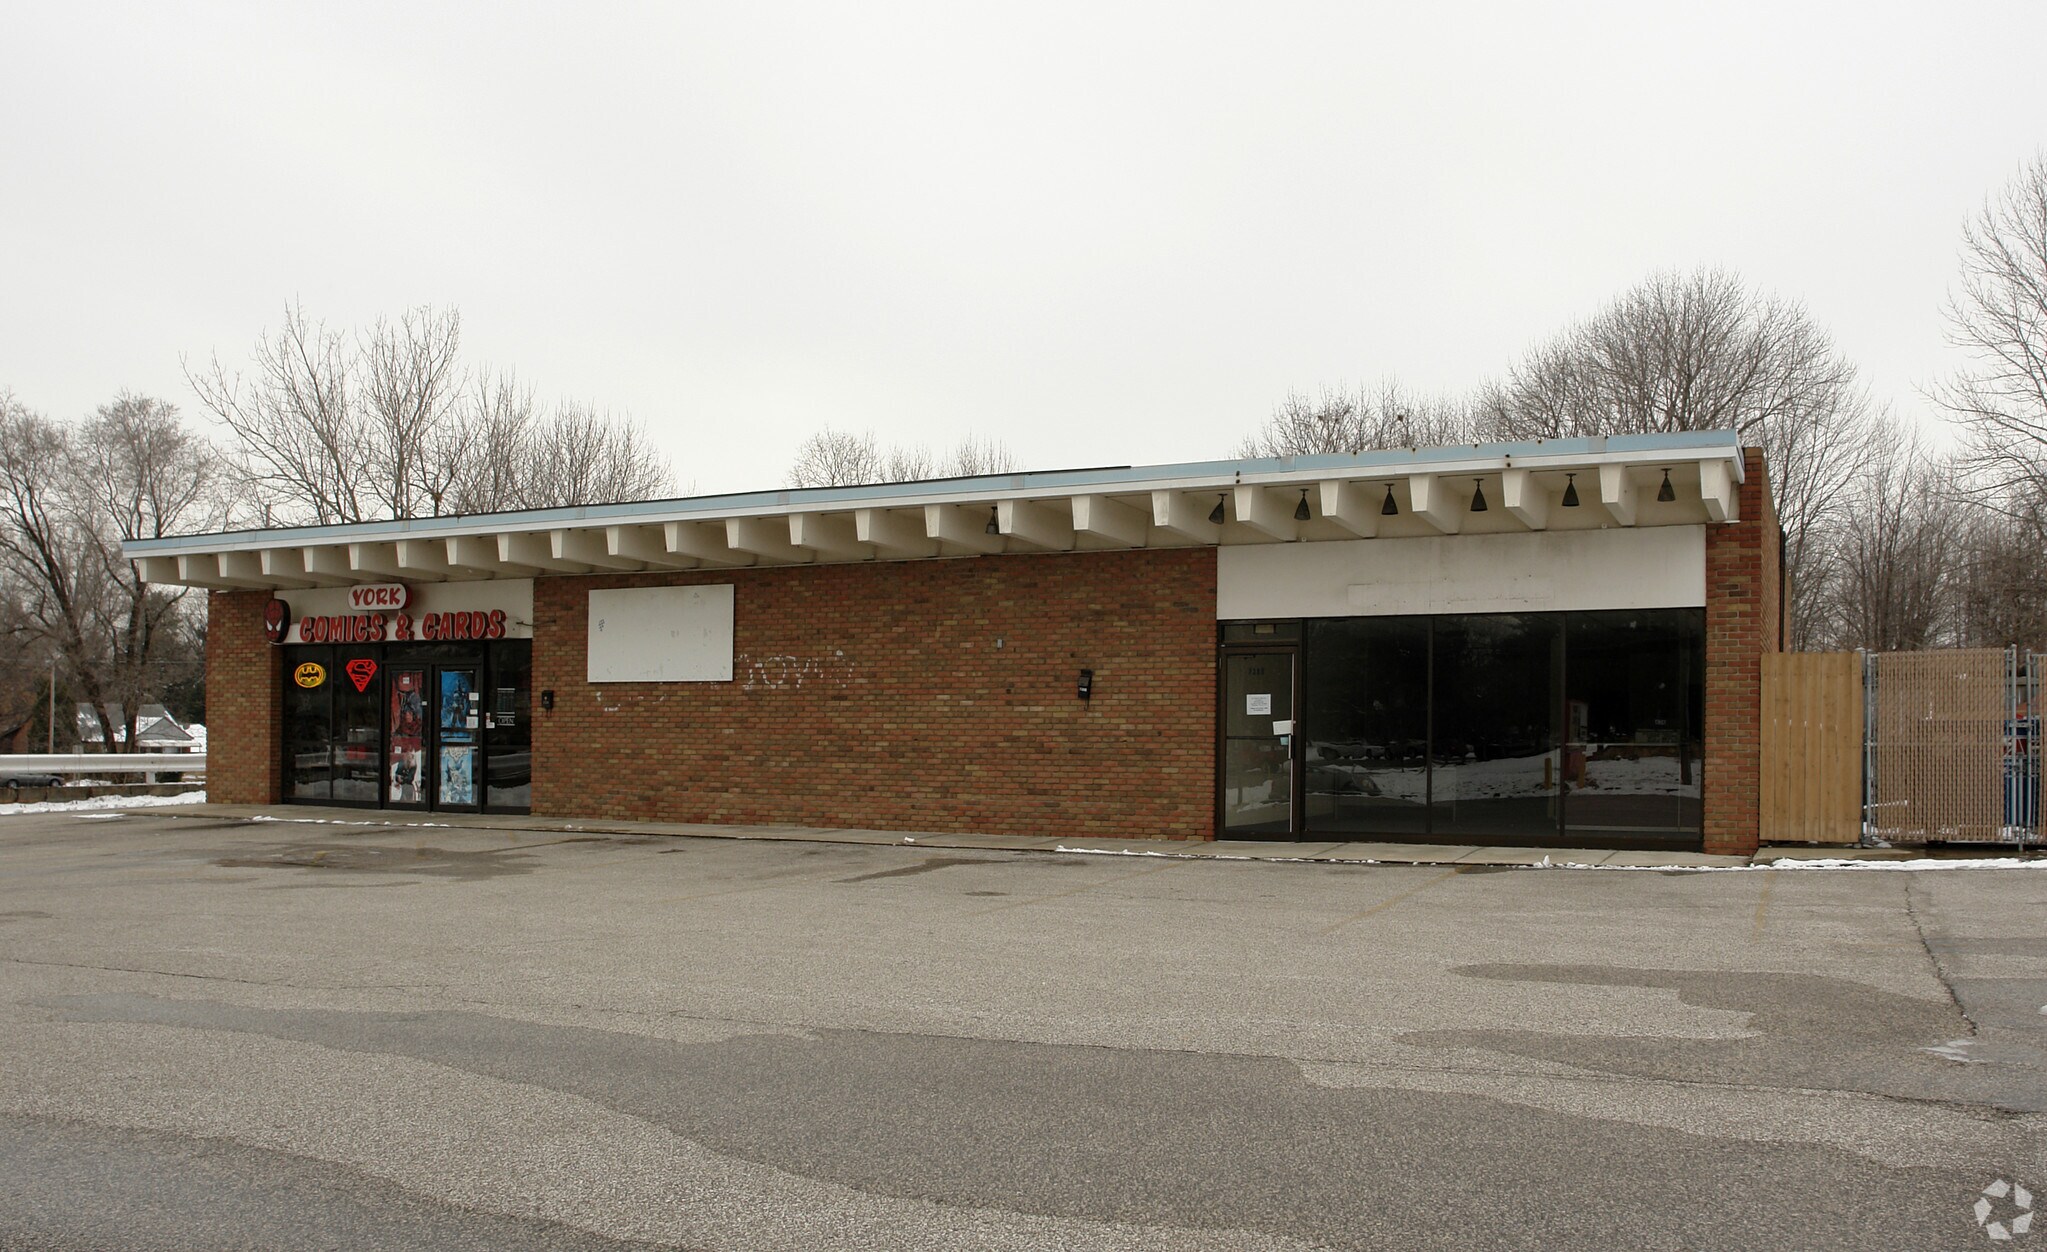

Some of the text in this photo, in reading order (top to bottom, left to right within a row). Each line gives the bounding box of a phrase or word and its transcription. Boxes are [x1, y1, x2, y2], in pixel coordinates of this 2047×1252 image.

[352, 587, 401, 606] YORK
[299, 609, 506, 643] COMICS & CARDS
